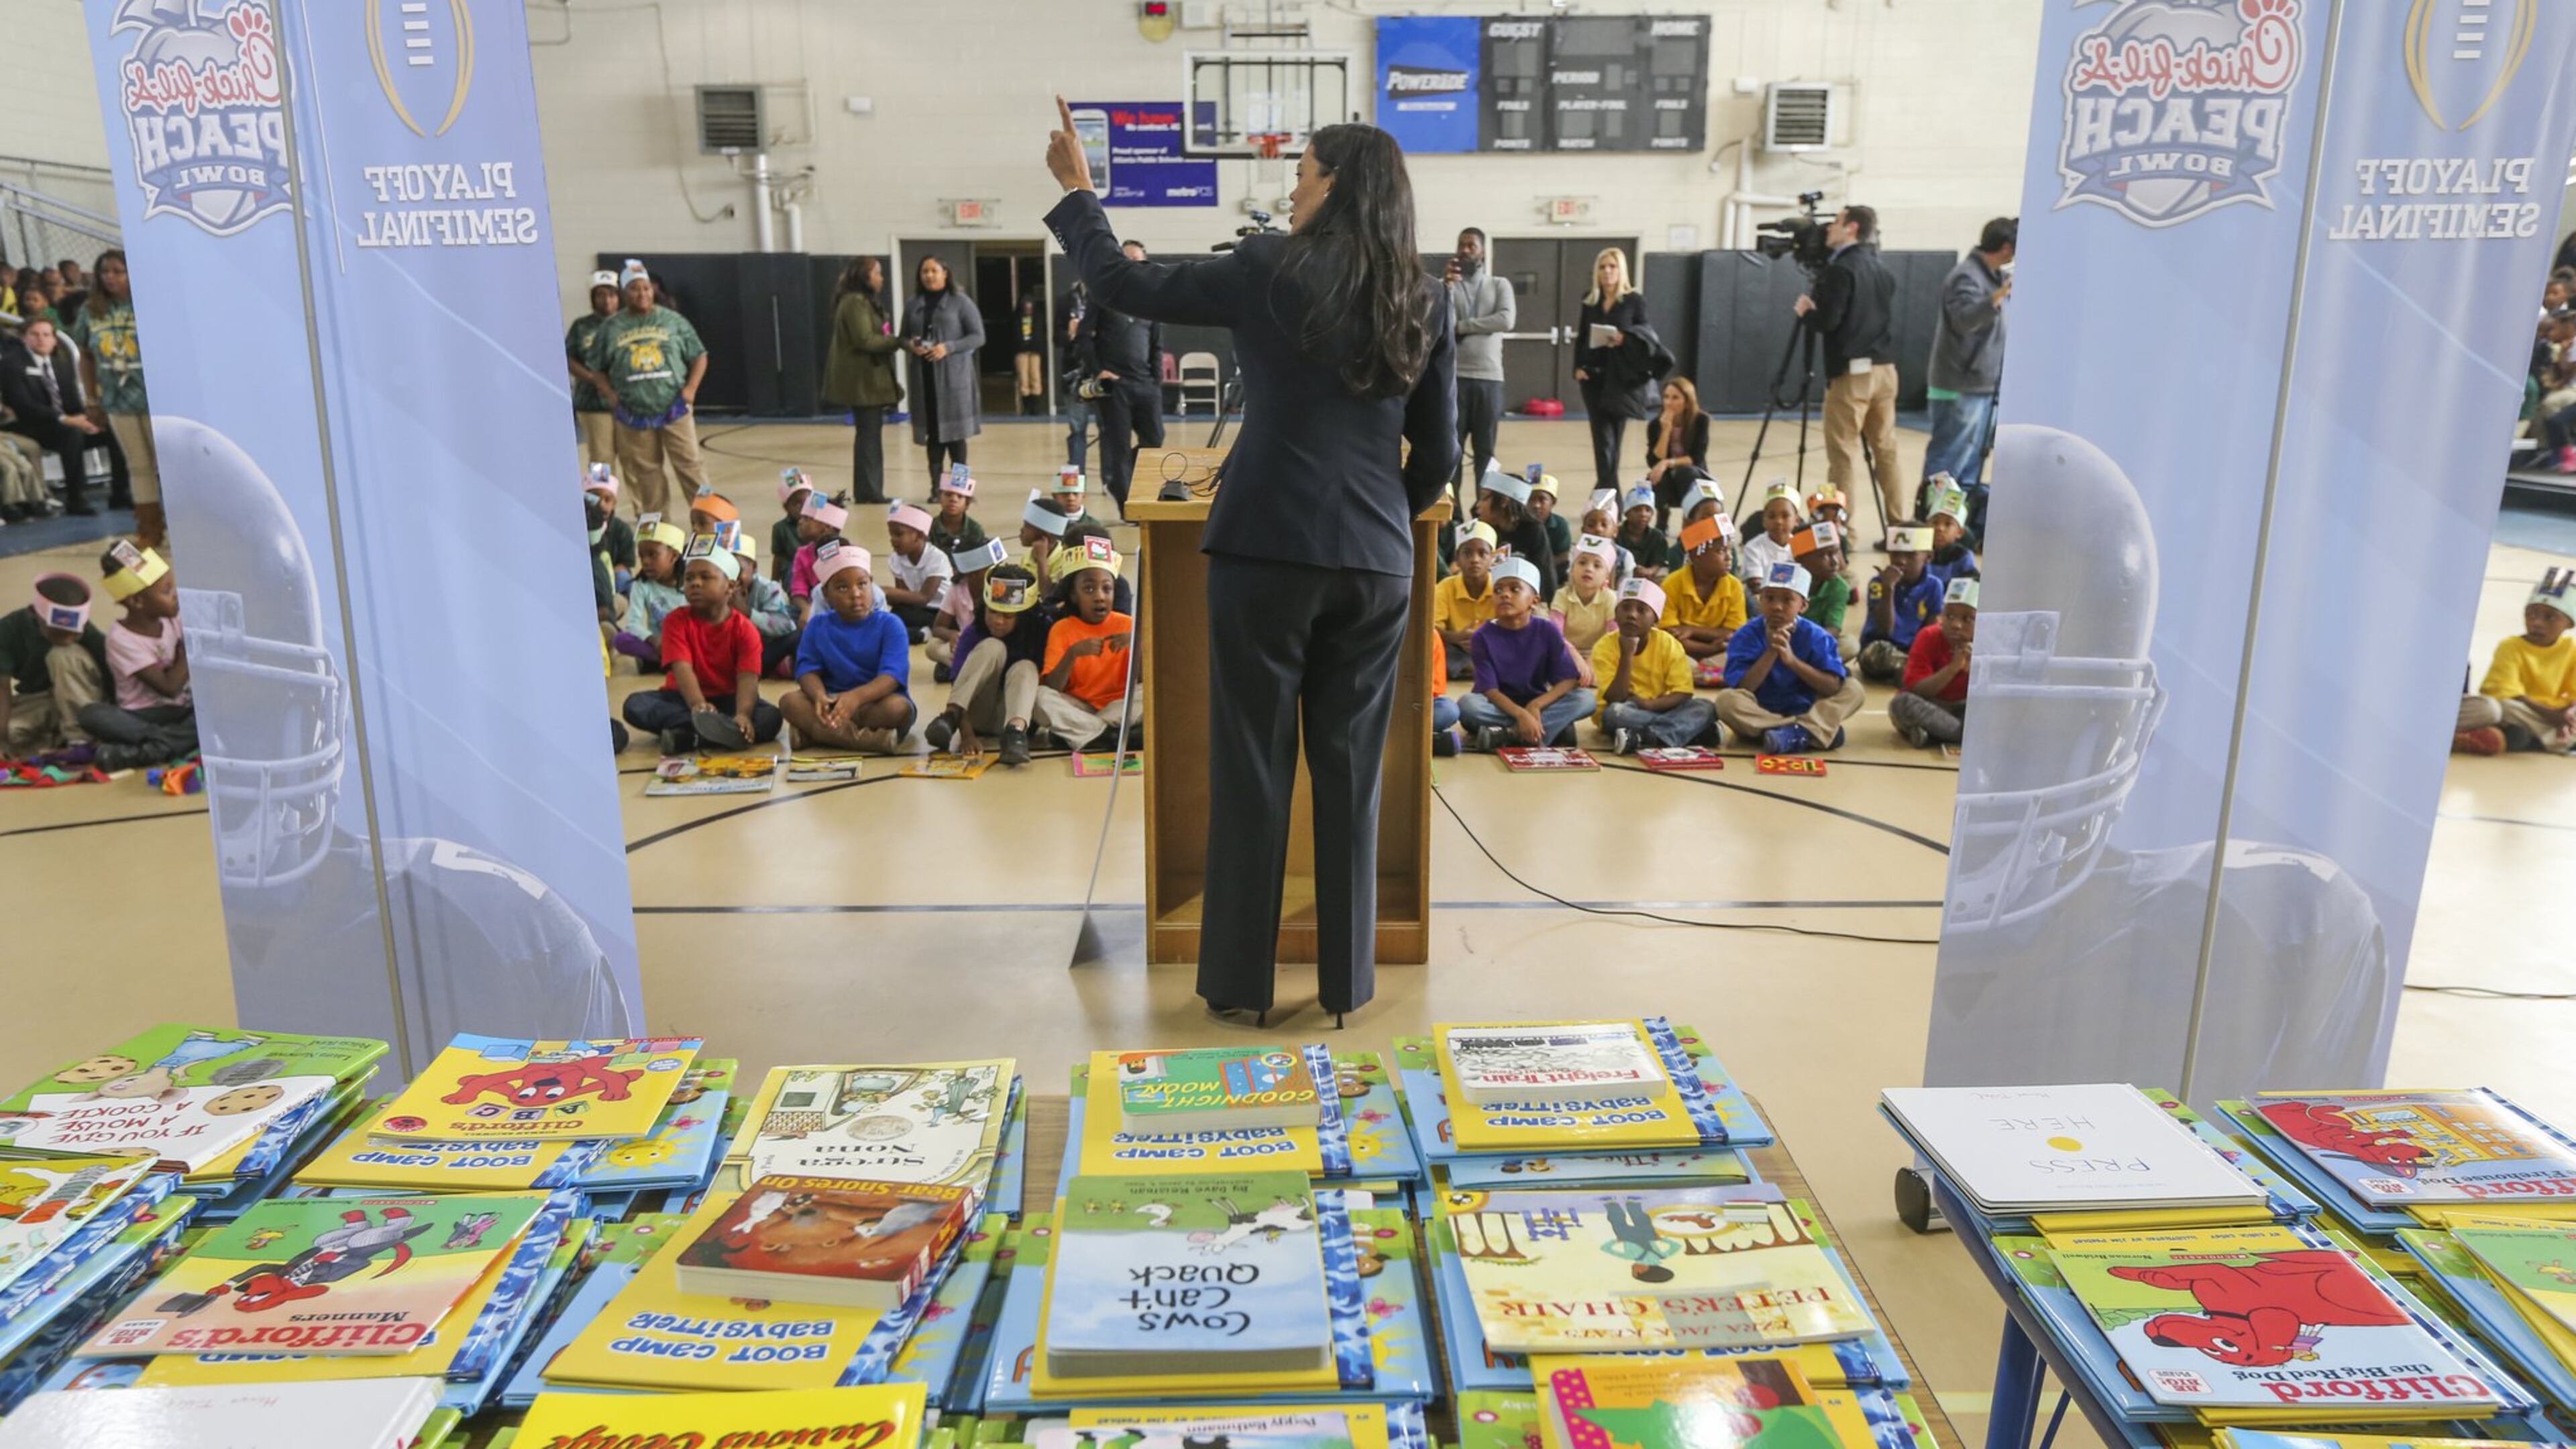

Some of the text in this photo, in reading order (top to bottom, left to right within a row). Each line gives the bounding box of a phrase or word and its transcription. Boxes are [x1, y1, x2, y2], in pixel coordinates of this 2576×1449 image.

[1489, 23, 1542, 37] GUEST
[1651, 21, 1701, 36] HOME
[1552, 72, 1600, 83] PERIOD
[1483, 1070, 1640, 1085] Freight Train
[1141, 1081, 1220, 1096] MOON
[1157, 1090, 1315, 1108] GOODNIGHT
[53, 1102, 193, 1120] A COOKIE
[474, 1108, 499, 1116] C
[514, 1111, 535, 1120] B
[1591, 1110, 1666, 1126] BOOT
[56, 1115, 179, 1132] A MOUSE
[449, 1120, 584, 1132] Clifford's
[1988, 1116, 2095, 1130] HERE
[48, 1124, 209, 1145] IF YOU GIVE
[812, 1144, 916, 1154] Nona
[1218, 1141, 1297, 1158] BOOT
[449, 1155, 532, 1167] BOOT
[797, 1157, 924, 1167] Strega
[2029, 1157, 2150, 1174] PRESS
[759, 1176, 800, 1190] On
[804, 1178, 896, 1196] Snores
[2450, 1179, 2576, 1199] fford
[900, 1185, 963, 1201] Bear
[1128, 1263, 1259, 1287] Quack
[1118, 1287, 1231, 1310] Can't
[1501, 1287, 1831, 1316] PETER'S CHAIR
[288, 1311, 408, 1324] Manners
[1138, 1311, 1250, 1337] Cows
[165, 1322, 427, 1350] Clifford's
[727, 1344, 828, 1362] BOOT
[2232, 1364, 2432, 1382] the Big Red Dog
[2259, 1375, 2489, 1403] Clifford
[1186, 1415, 1316, 1434] Peggy Rathmann
